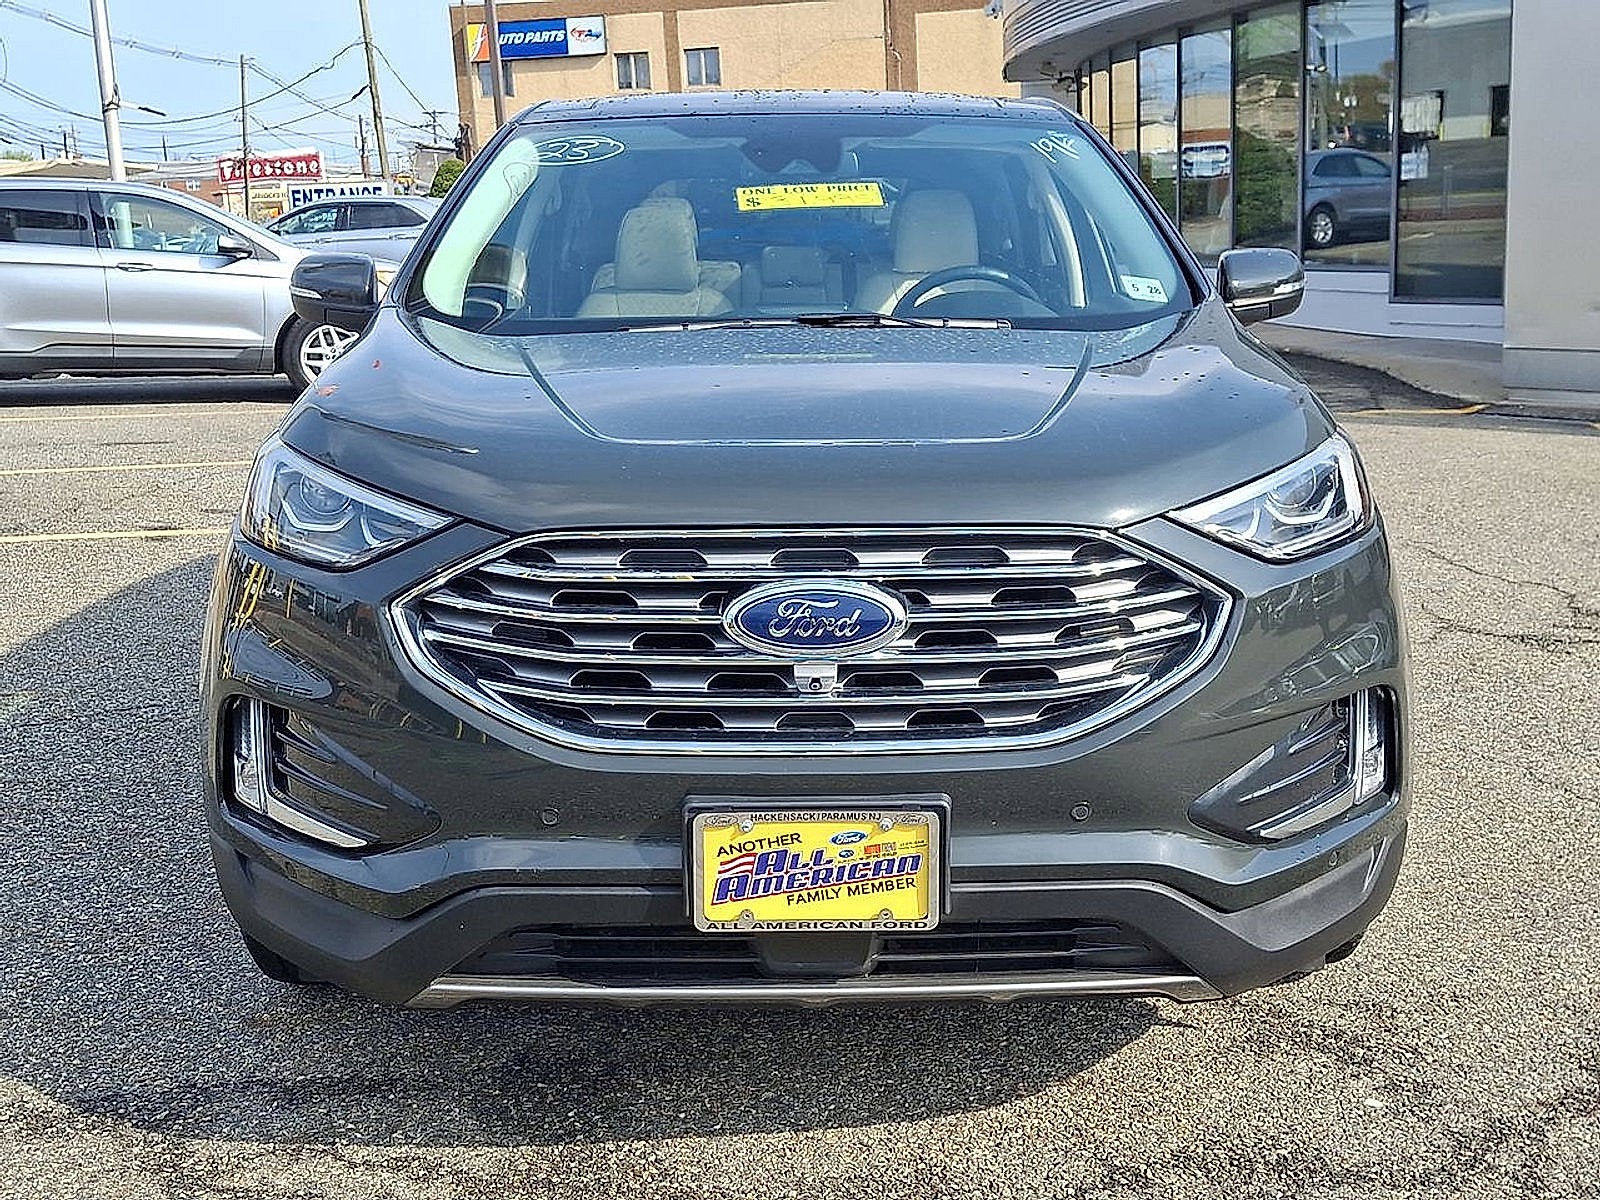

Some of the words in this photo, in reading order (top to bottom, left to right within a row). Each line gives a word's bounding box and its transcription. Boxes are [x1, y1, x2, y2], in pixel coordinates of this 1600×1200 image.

[524, 29, 567, 44] PARTS
[742, 186, 776, 195] ONE
[783, 185, 819, 194] LOW
[826, 184, 873, 193] PRICE
[768, 598, 864, 638] Ford
[868, 812, 882, 821] NJ
[716, 832, 803, 858] ANOTHER
[834, 832, 863, 845] Ford
[786, 886, 842, 906] FAMILY
[847, 876, 917, 897] MEMBER
[706, 920, 745, 930] ALL
[751, 920, 863, 930] AMERICAN
[871, 920, 929, 930] FORD
